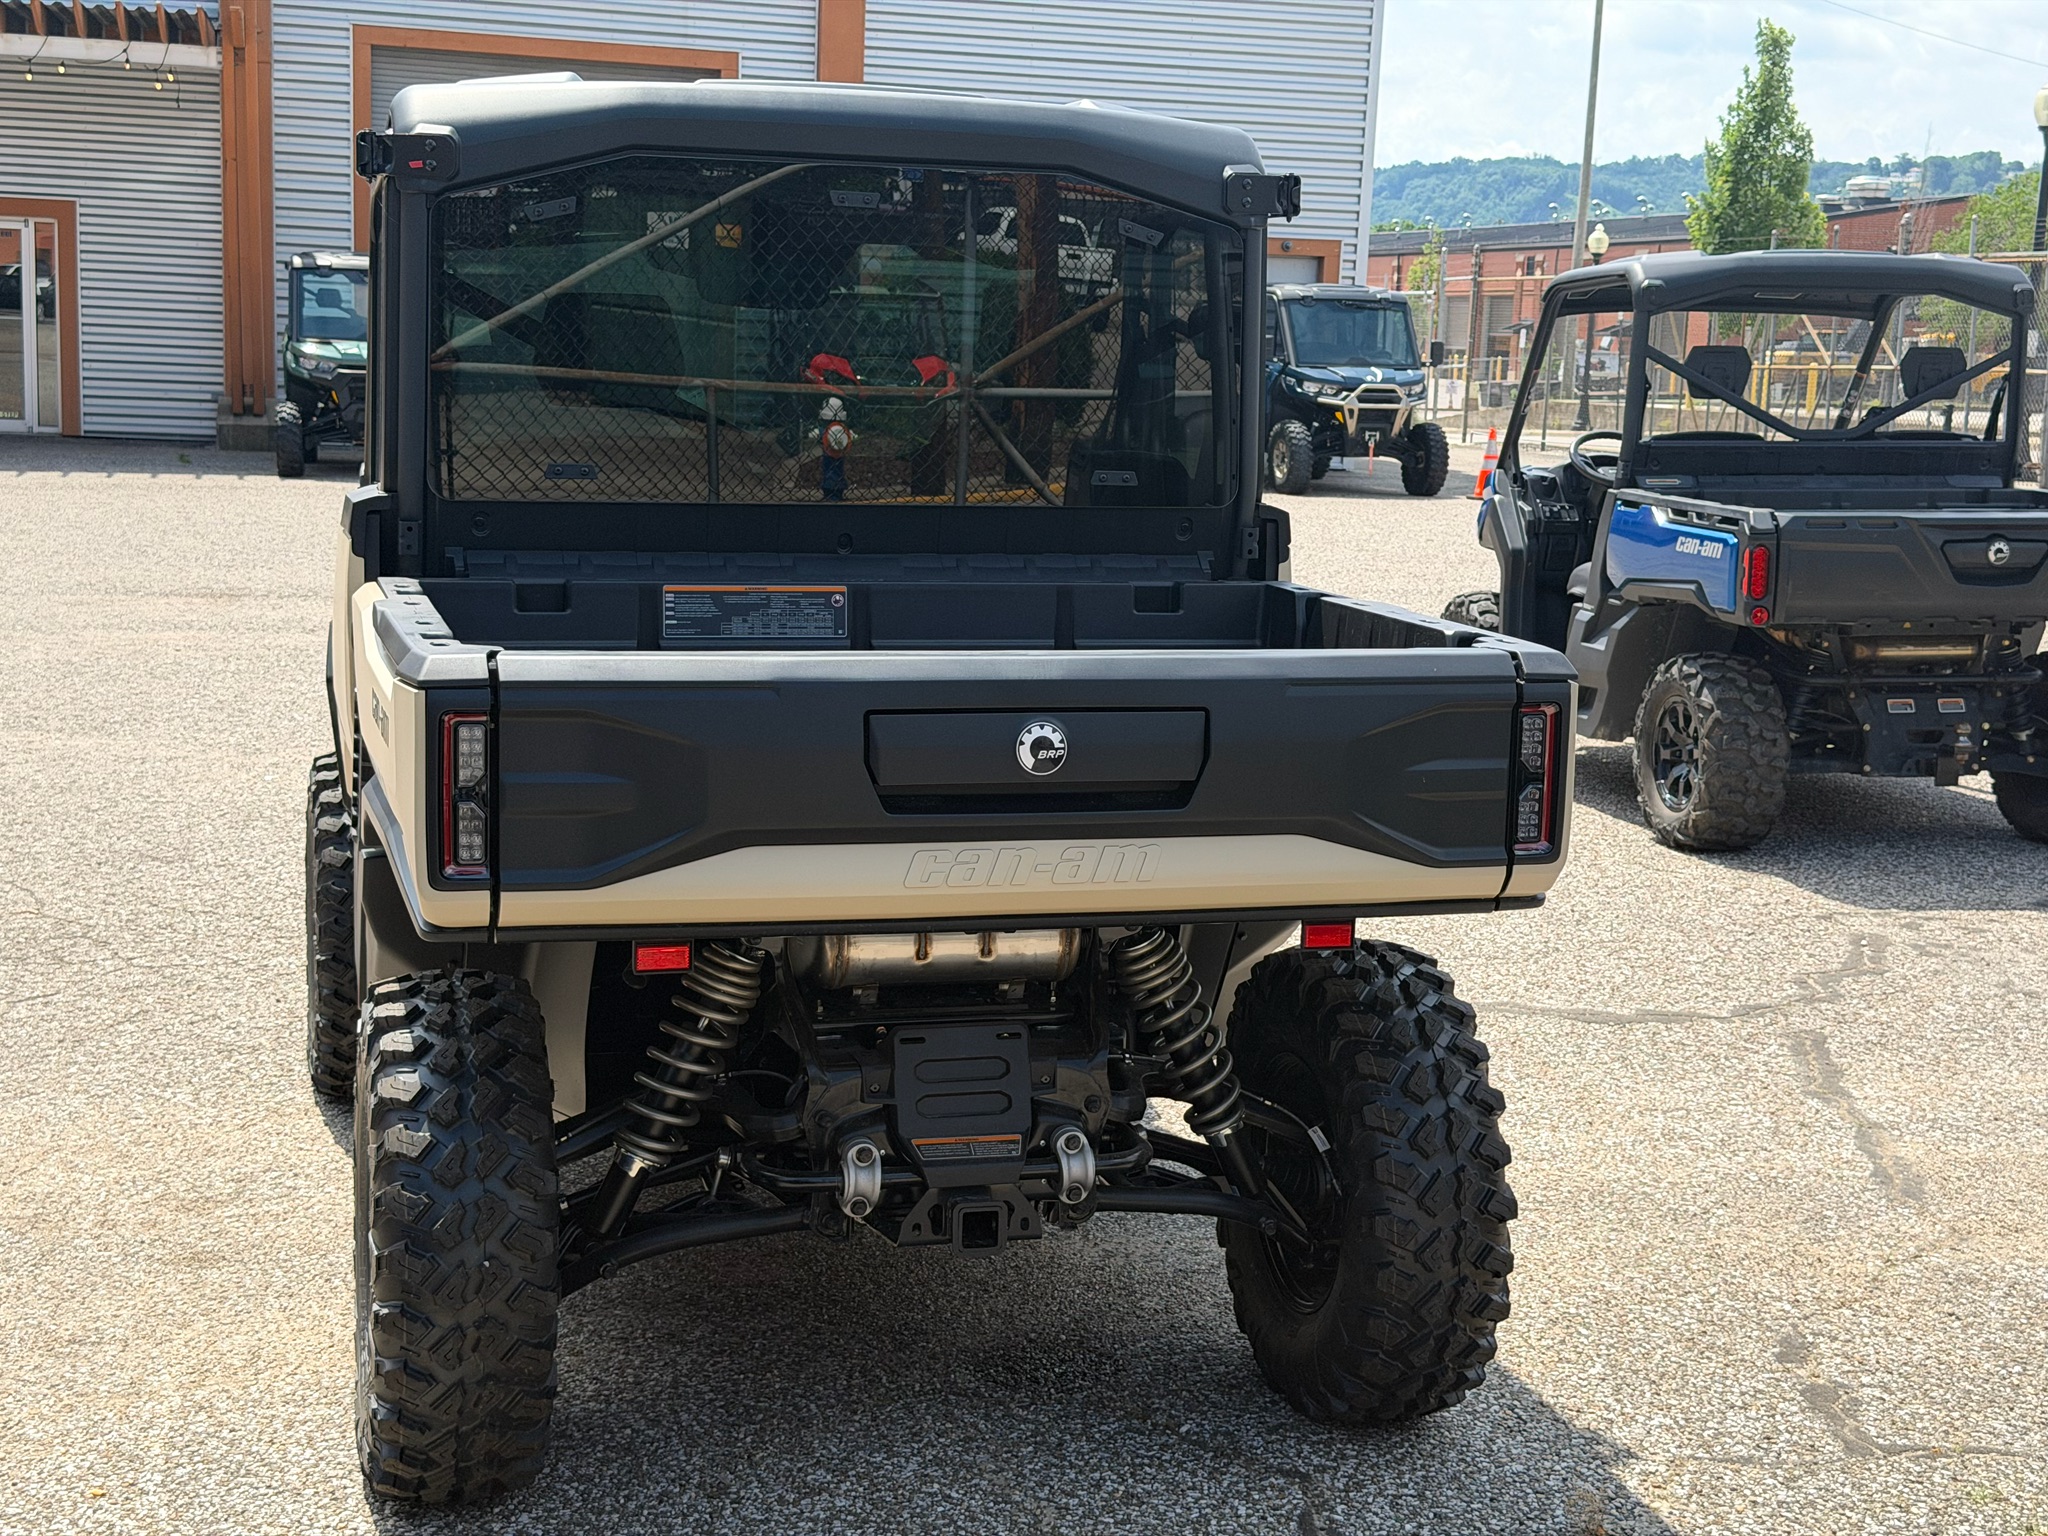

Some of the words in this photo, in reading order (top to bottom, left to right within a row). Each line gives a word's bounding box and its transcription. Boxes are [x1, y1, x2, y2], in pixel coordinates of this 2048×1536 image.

[1675, 536, 1724, 559] can-am
[1037, 749, 1065, 759] BRP
[903, 843, 1163, 889] can-am
